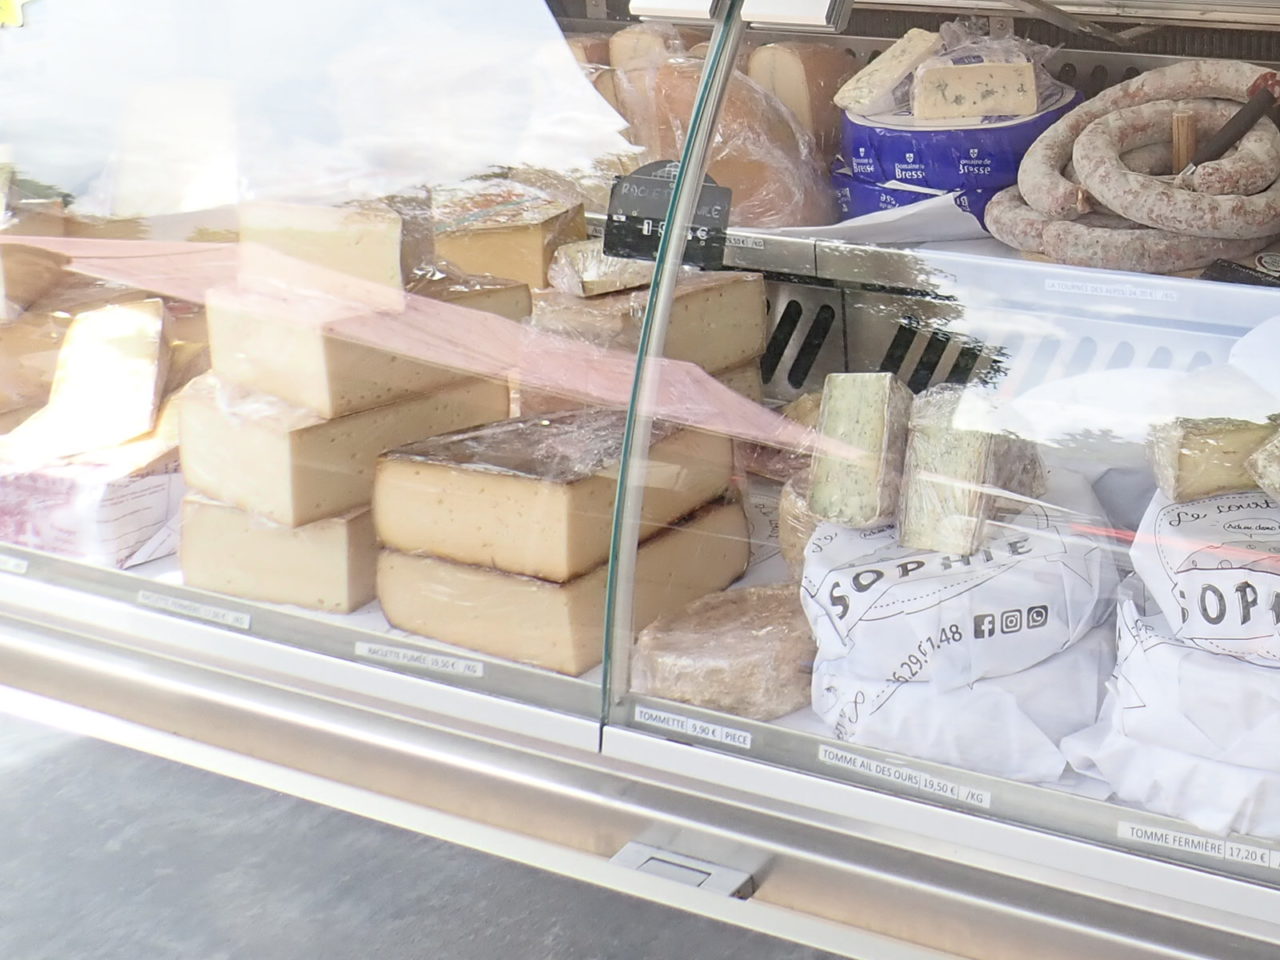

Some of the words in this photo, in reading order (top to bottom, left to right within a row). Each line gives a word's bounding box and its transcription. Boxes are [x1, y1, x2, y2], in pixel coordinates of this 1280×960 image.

[1216, 499, 1278, 515] court
[829, 538, 1033, 620] SOPHIE
[638, 709, 687, 729] TOMMETTE
[822, 748, 858, 767] TOMME
[859, 758, 873, 771] AIL
[875, 762, 892, 777] DES
[893, 767, 919, 785] OURS
[923, 775, 948, 794] 19,50
[950, 784, 956, 796] €
[965, 788, 983, 804] /KG
[1130, 826, 1170, 845] TOMME
[1172, 834, 1223, 855] FERMIÈRE
[1229, 846, 1258, 862] 17,20
[1260, 851, 1266, 863] €
